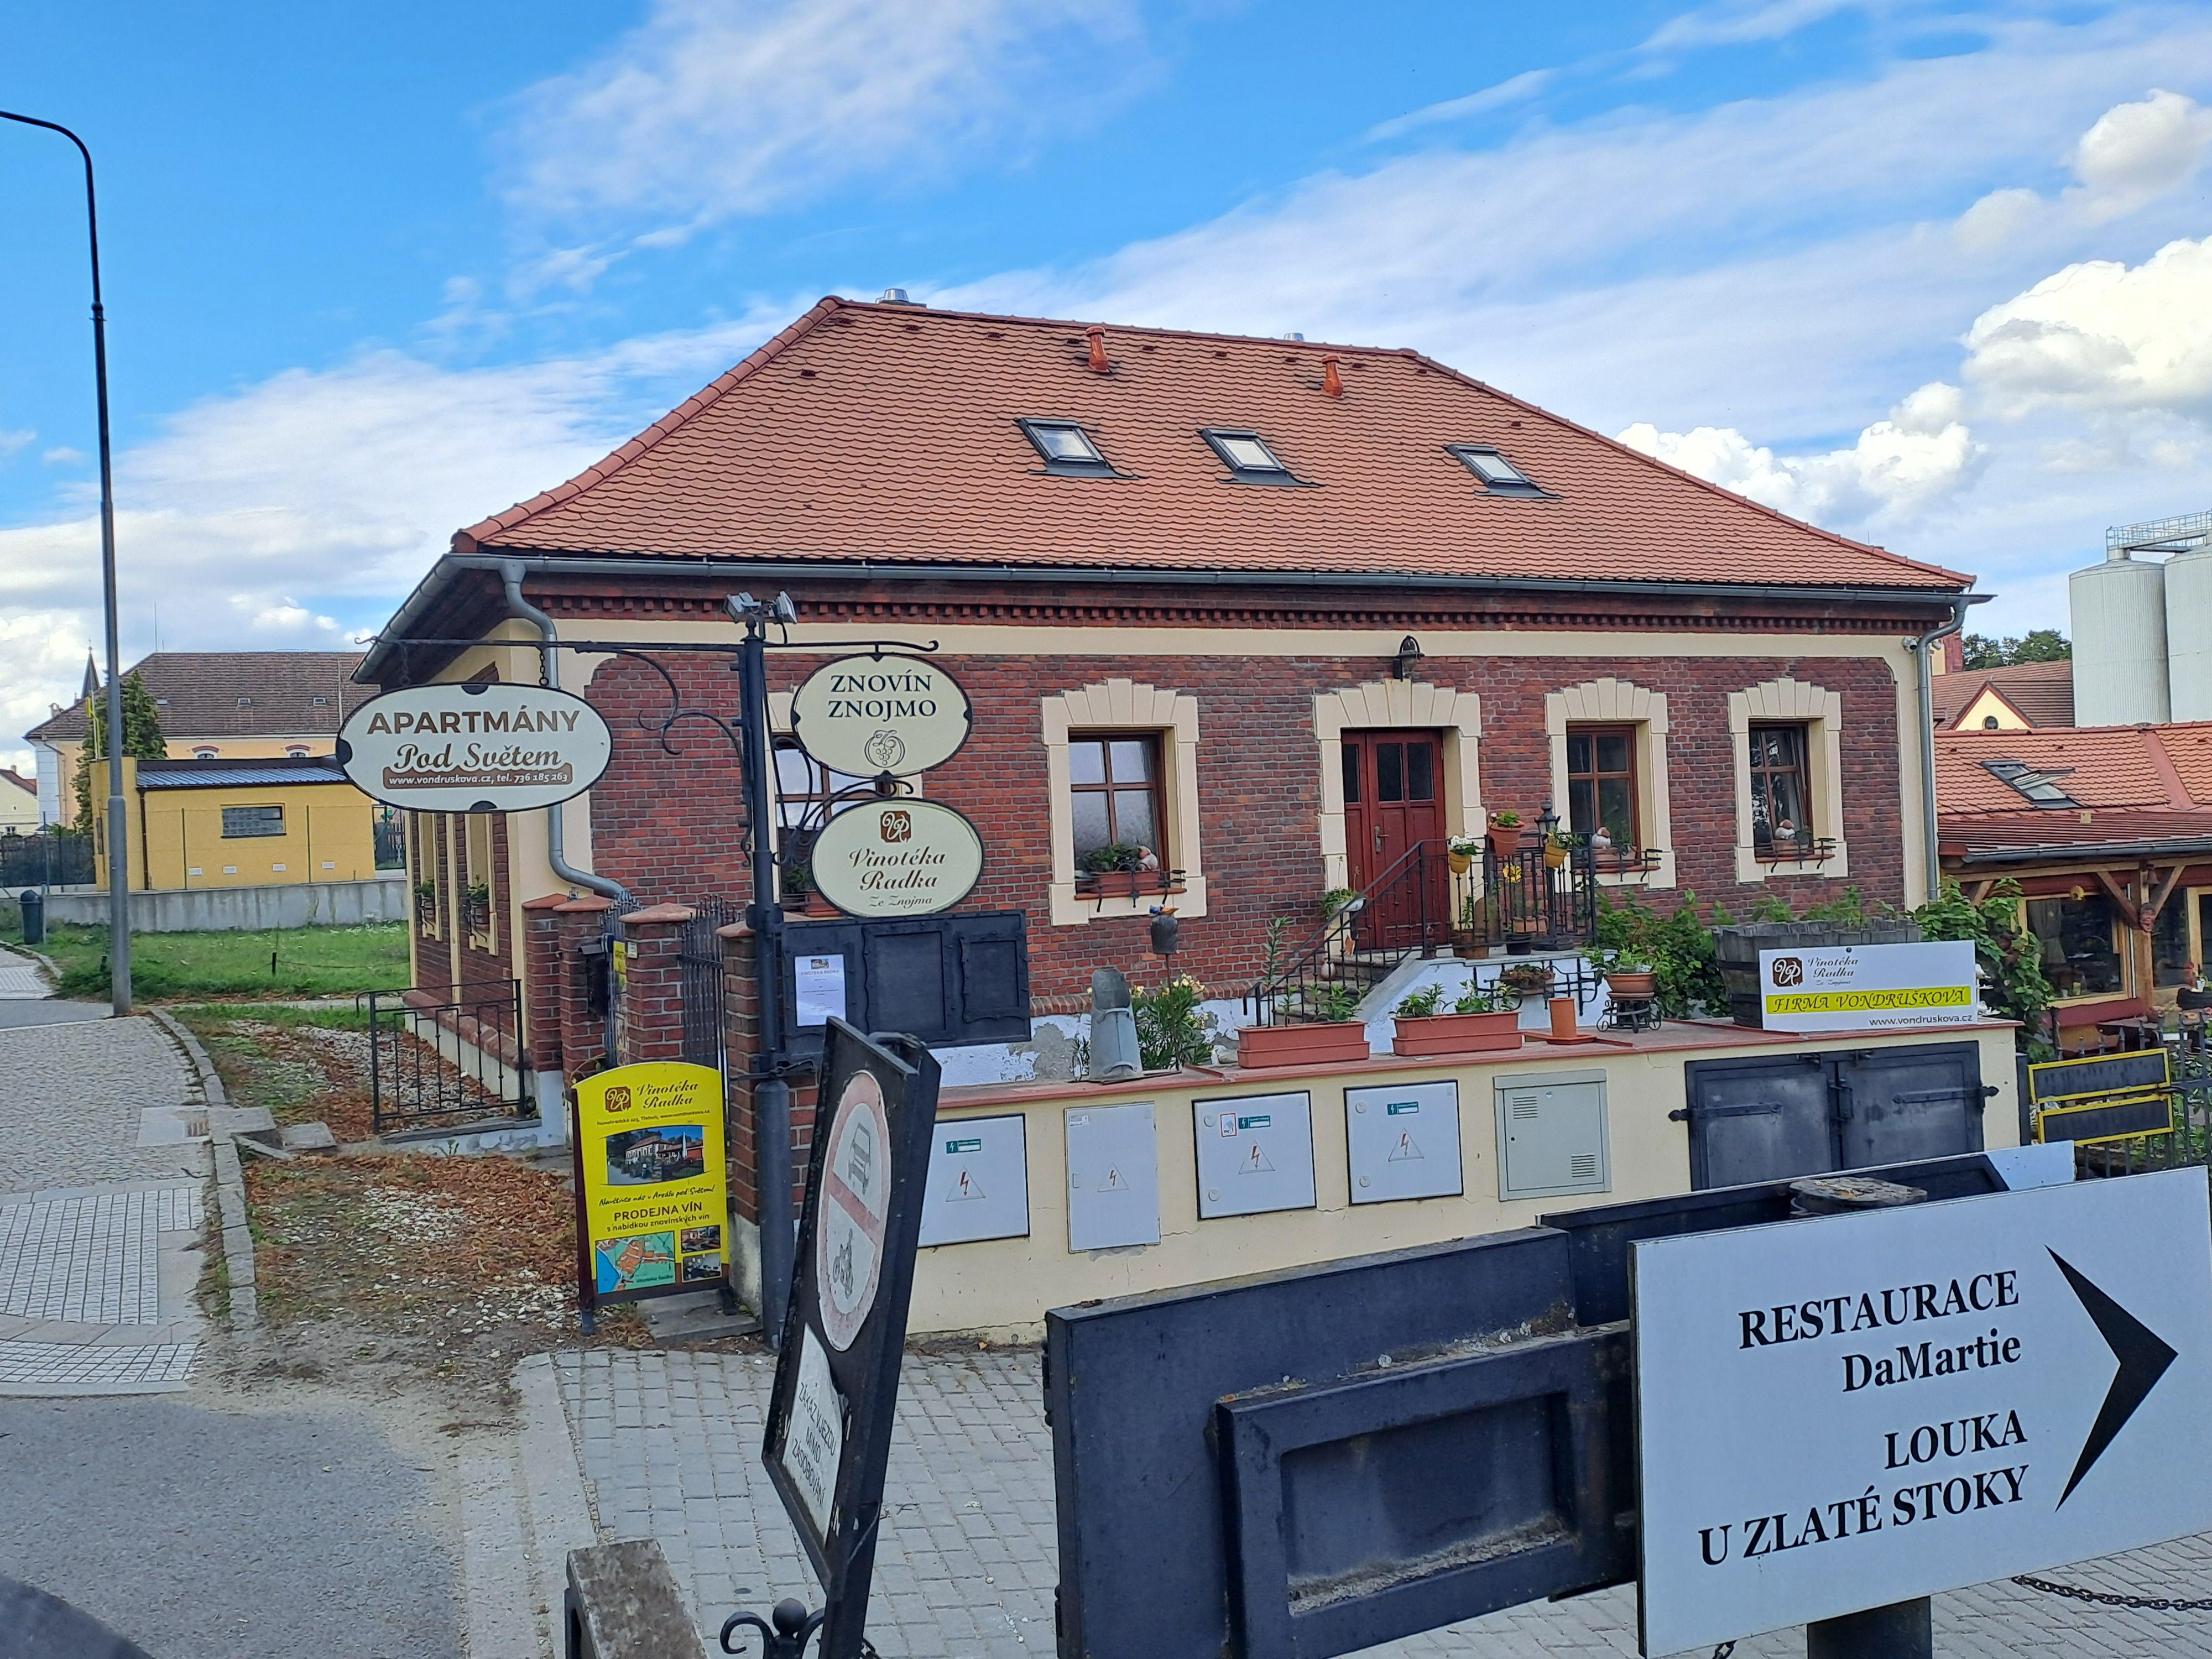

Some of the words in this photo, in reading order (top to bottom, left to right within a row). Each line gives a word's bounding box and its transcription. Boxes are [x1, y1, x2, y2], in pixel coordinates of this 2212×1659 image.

[831, 669, 933, 693] ZNOVÍN
[367, 705, 580, 734] APARTMÁNY
[828, 699, 937, 722] ZNOJMO
[394, 743, 453, 769] Pod
[463, 743, 562, 768] Světem
[389, 775, 494, 785] www.vondruskova.cz,
[497, 773, 512, 782] tel.
[513, 773, 530, 784] 736
[533, 773, 549, 783] 185
[551, 773, 568, 782] 263
[849, 846, 946, 868] Vinotéka
[859, 869, 938, 891] Radka
[869, 895, 884, 907] Ze
[889, 895, 933, 909] Znojma
[1808, 956, 1859, 967] Vinotéka
[1813, 967, 1854, 978] Radka
[1773, 995, 1829, 1013] FIRMA
[1836, 987, 1965, 1009] VONDRUŠKOVÁ
[1869, 1014, 1973, 1026] www.vondruskova.cz
[637, 1080, 698, 1096] Vinotéka
[643, 1094, 693, 1109] Radka
[676, 1188, 689, 1198] pod
[614, 1204, 679, 1222] PRODEJNA
[681, 1201, 702, 1213] VÍN
[1738, 1270, 2020, 1349] RESTAURACE
[1841, 1328, 2021, 1392] DaMartie
[799, 1381, 817, 1422] ZÁKAZ
[816, 1410, 837, 1457] VJEZDU
[805, 1426, 821, 1464] MIMO
[1884, 1409, 2028, 1470] LOUKA
[792, 1437, 826, 1506] ZÁSOBOVÁNÍ
[1698, 1525, 1733, 1565] U
[1743, 1485, 1882, 1558] ZLATÉ
[1893, 1464, 2030, 1526] STOKY
